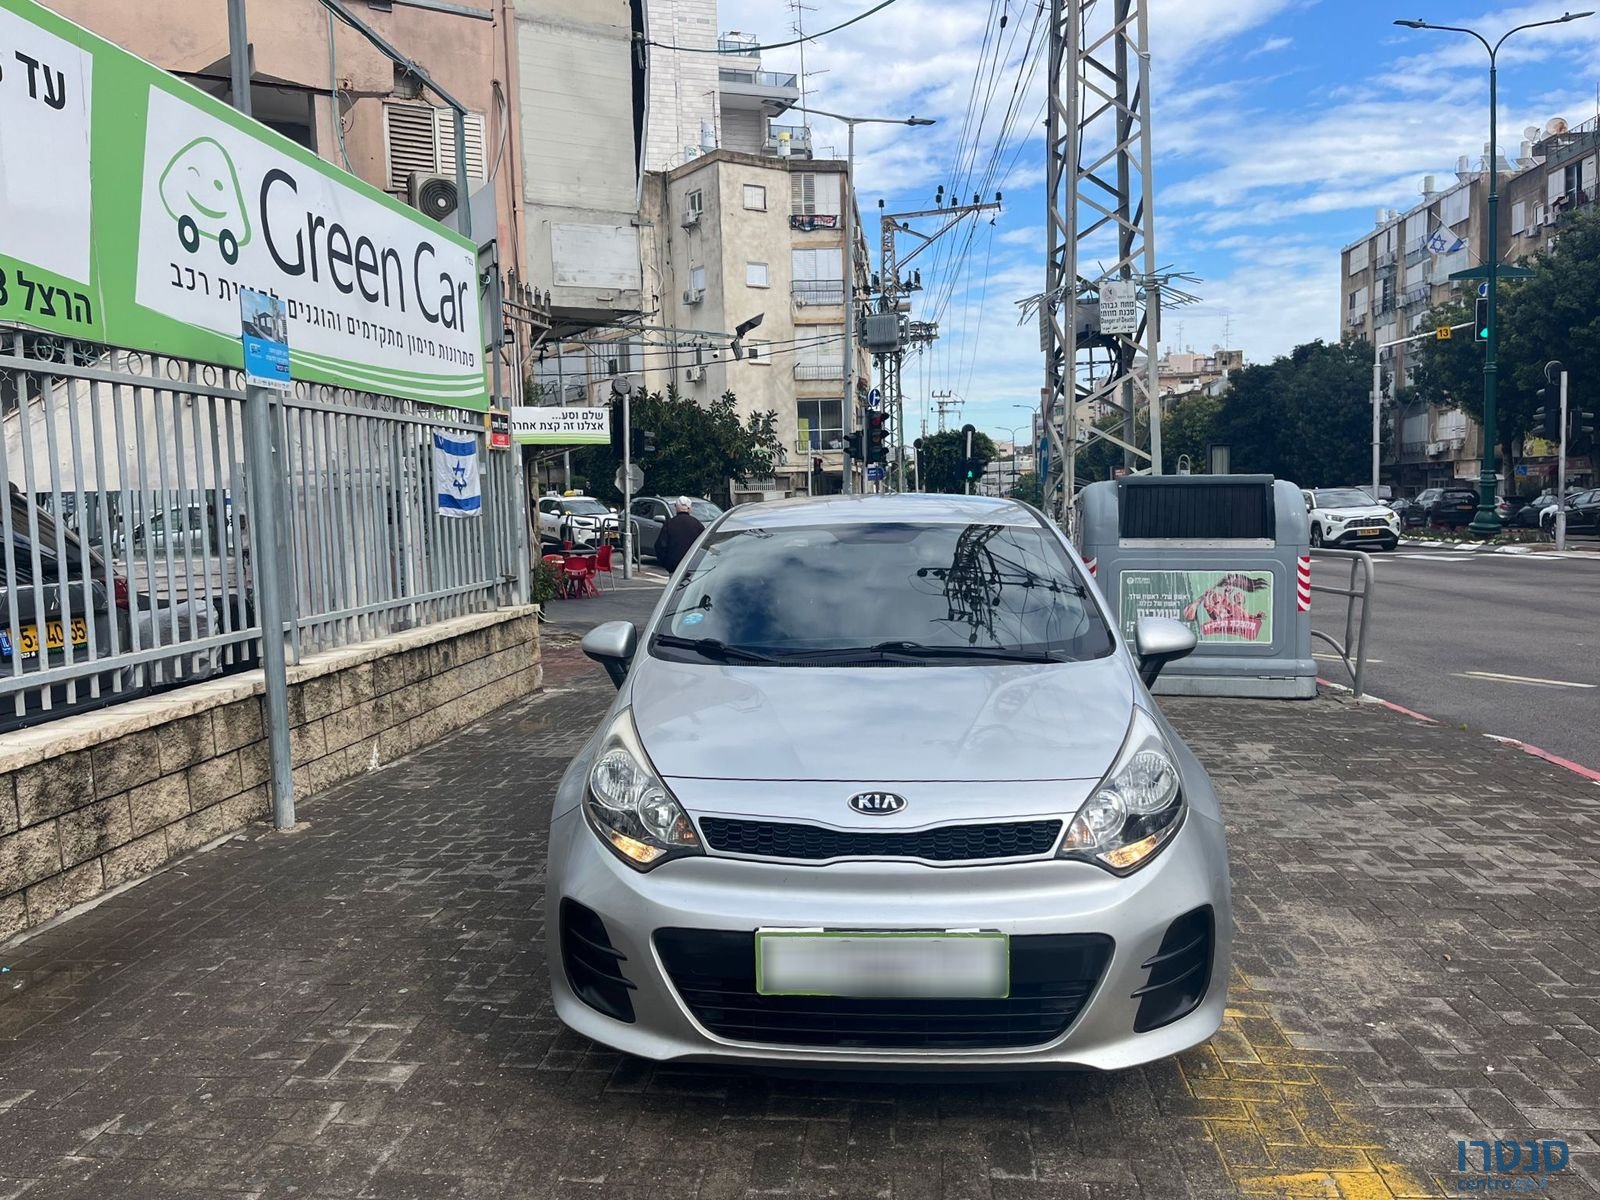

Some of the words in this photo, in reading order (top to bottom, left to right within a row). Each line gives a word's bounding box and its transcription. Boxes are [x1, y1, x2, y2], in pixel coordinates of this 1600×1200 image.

[15, 50, 66, 110] עד
[260, 168, 406, 313] Green
[414, 241, 468, 333] Car
[170, 262, 209, 295] רכב
[17, 270, 92, 325] הרצל
[288, 299, 341, 332] והוגנים
[347, 316, 404, 349] מתקדמים
[1439, 328, 1449, 337] 13
[407, 334, 435, 357] מימון
[438, 343, 475, 368] פתרונות
[539, 421, 560, 432] קצת
[563, 422, 574, 431] זה
[577, 420, 604, 431] אצלנו
[581, 410, 604, 420] שלם
[858, 794, 898, 809] KIA
